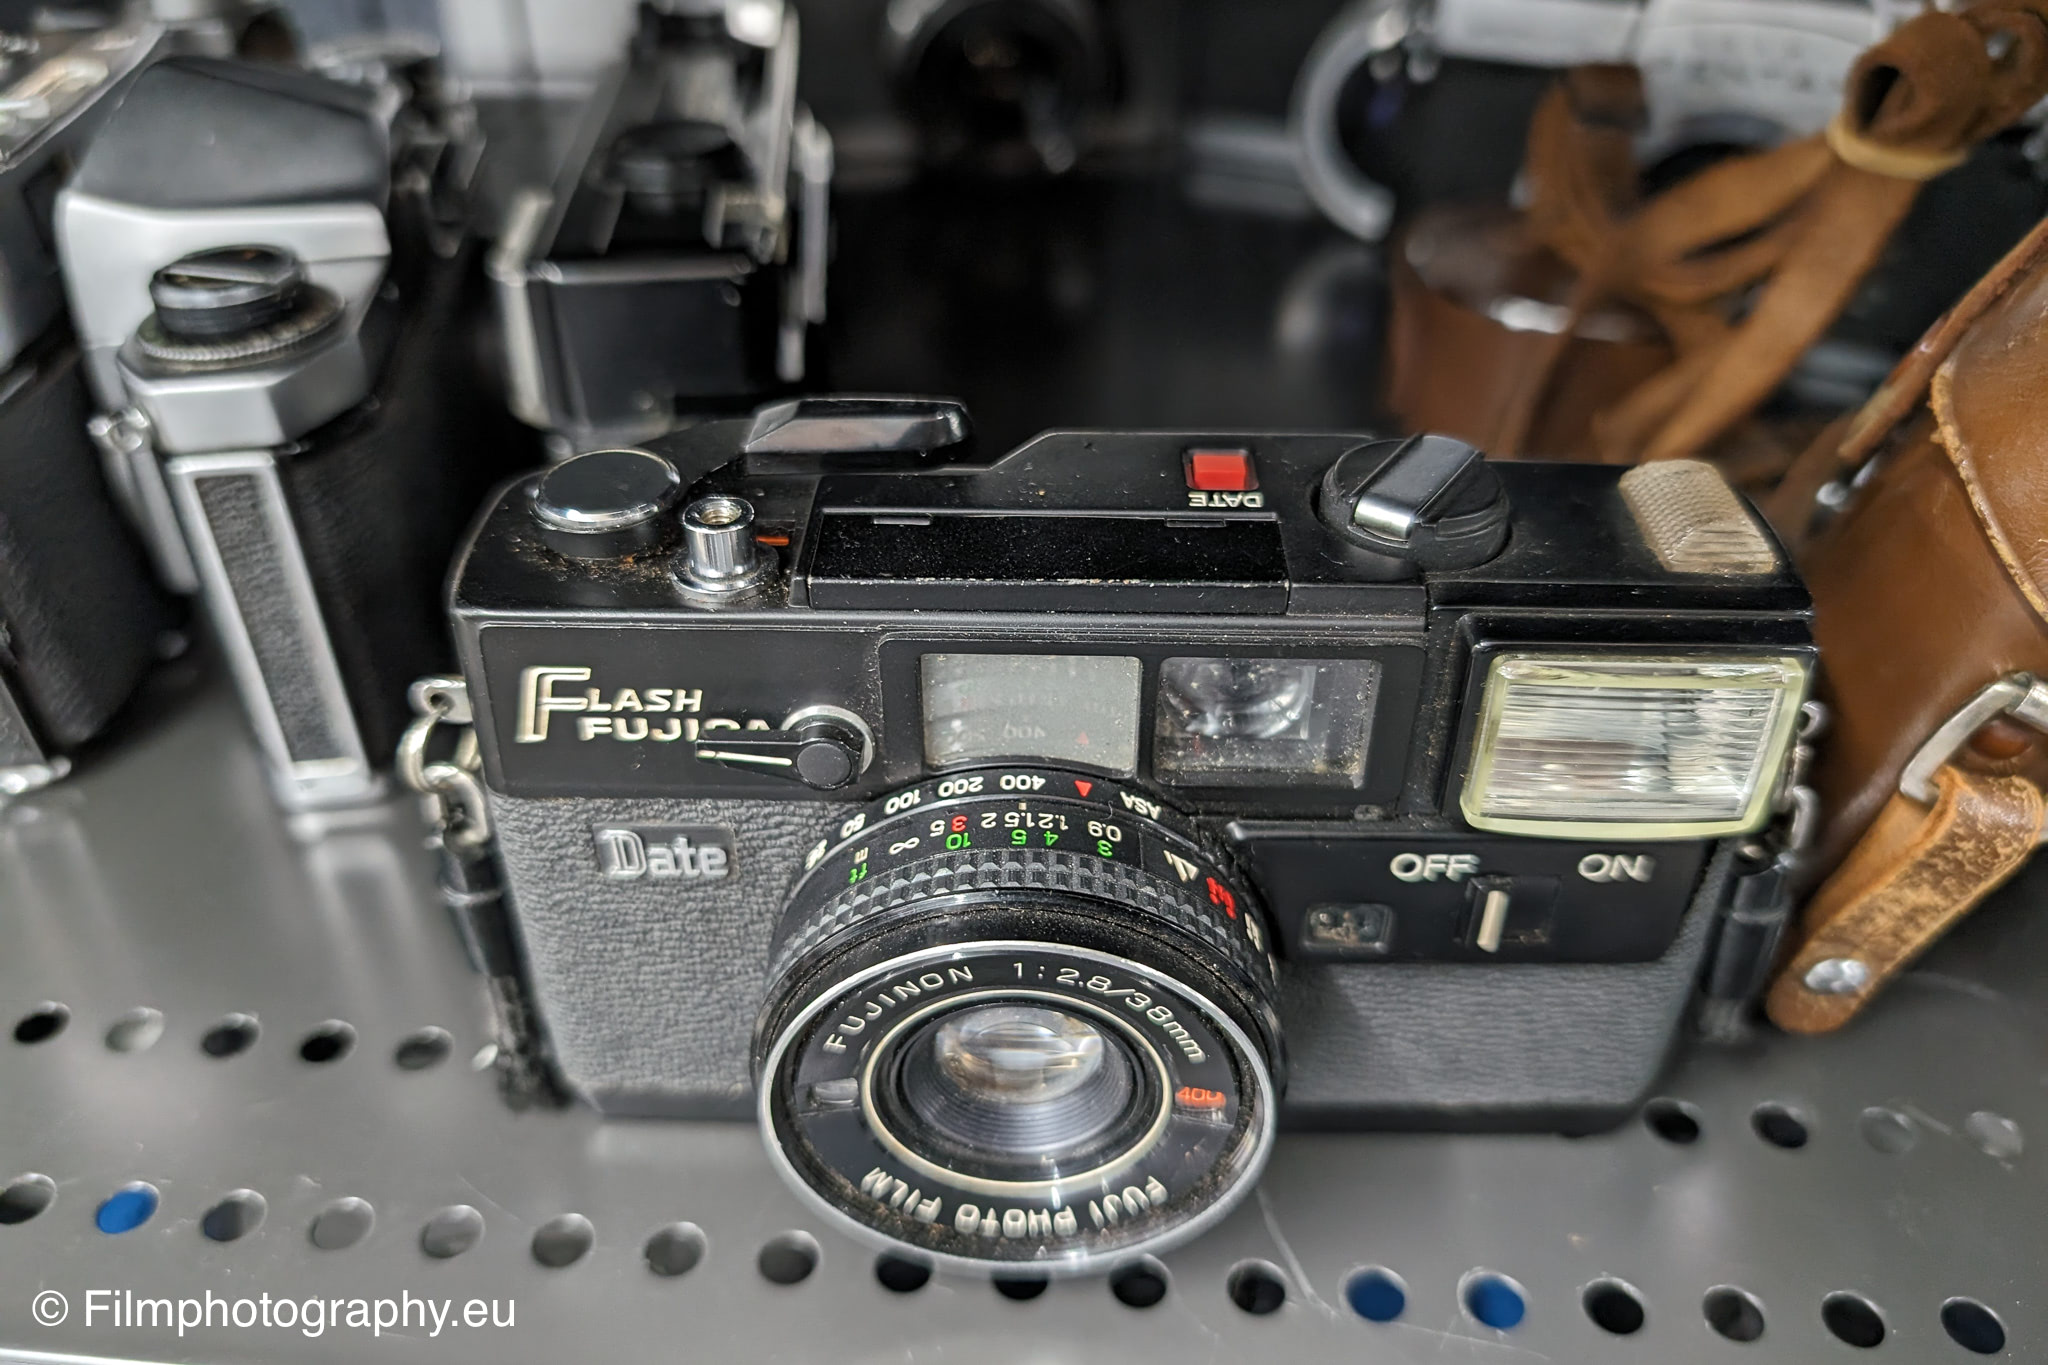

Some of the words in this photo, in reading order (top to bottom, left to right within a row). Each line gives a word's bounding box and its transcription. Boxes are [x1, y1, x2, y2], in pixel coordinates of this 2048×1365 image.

[1188, 491, 1264, 508] DATE
[515, 666, 703, 743] FLASH
[937, 776, 984, 798] 200
[1000, 774, 1047, 791] 400
[884, 789, 921, 815] 100
[1119, 791, 1162, 821] ASA
[930, 819, 946, 838] 5
[951, 815, 969, 833] 3
[980, 812, 998, 829] 2
[1004, 811, 1035, 829] 1.5
[1038, 812, 1069, 832] 1.2
[945, 832, 972, 850] 10
[1011, 828, 1027, 846] 5
[1043, 830, 1060, 847] 4
[1087, 820, 1122, 843] 0.9
[598, 827, 731, 881] Date
[853, 846, 869, 864] m
[1097, 839, 1114, 858] 3
[849, 862, 868, 885] ft
[1390, 852, 1481, 883] OFF
[1577, 852, 1656, 883] ON
[823, 963, 975, 1056] FUJINON
[860, 1165, 943, 1225] FILM
[1088, 1175, 1168, 1230] FUJI
[954, 1203, 1078, 1240] PHOTO
